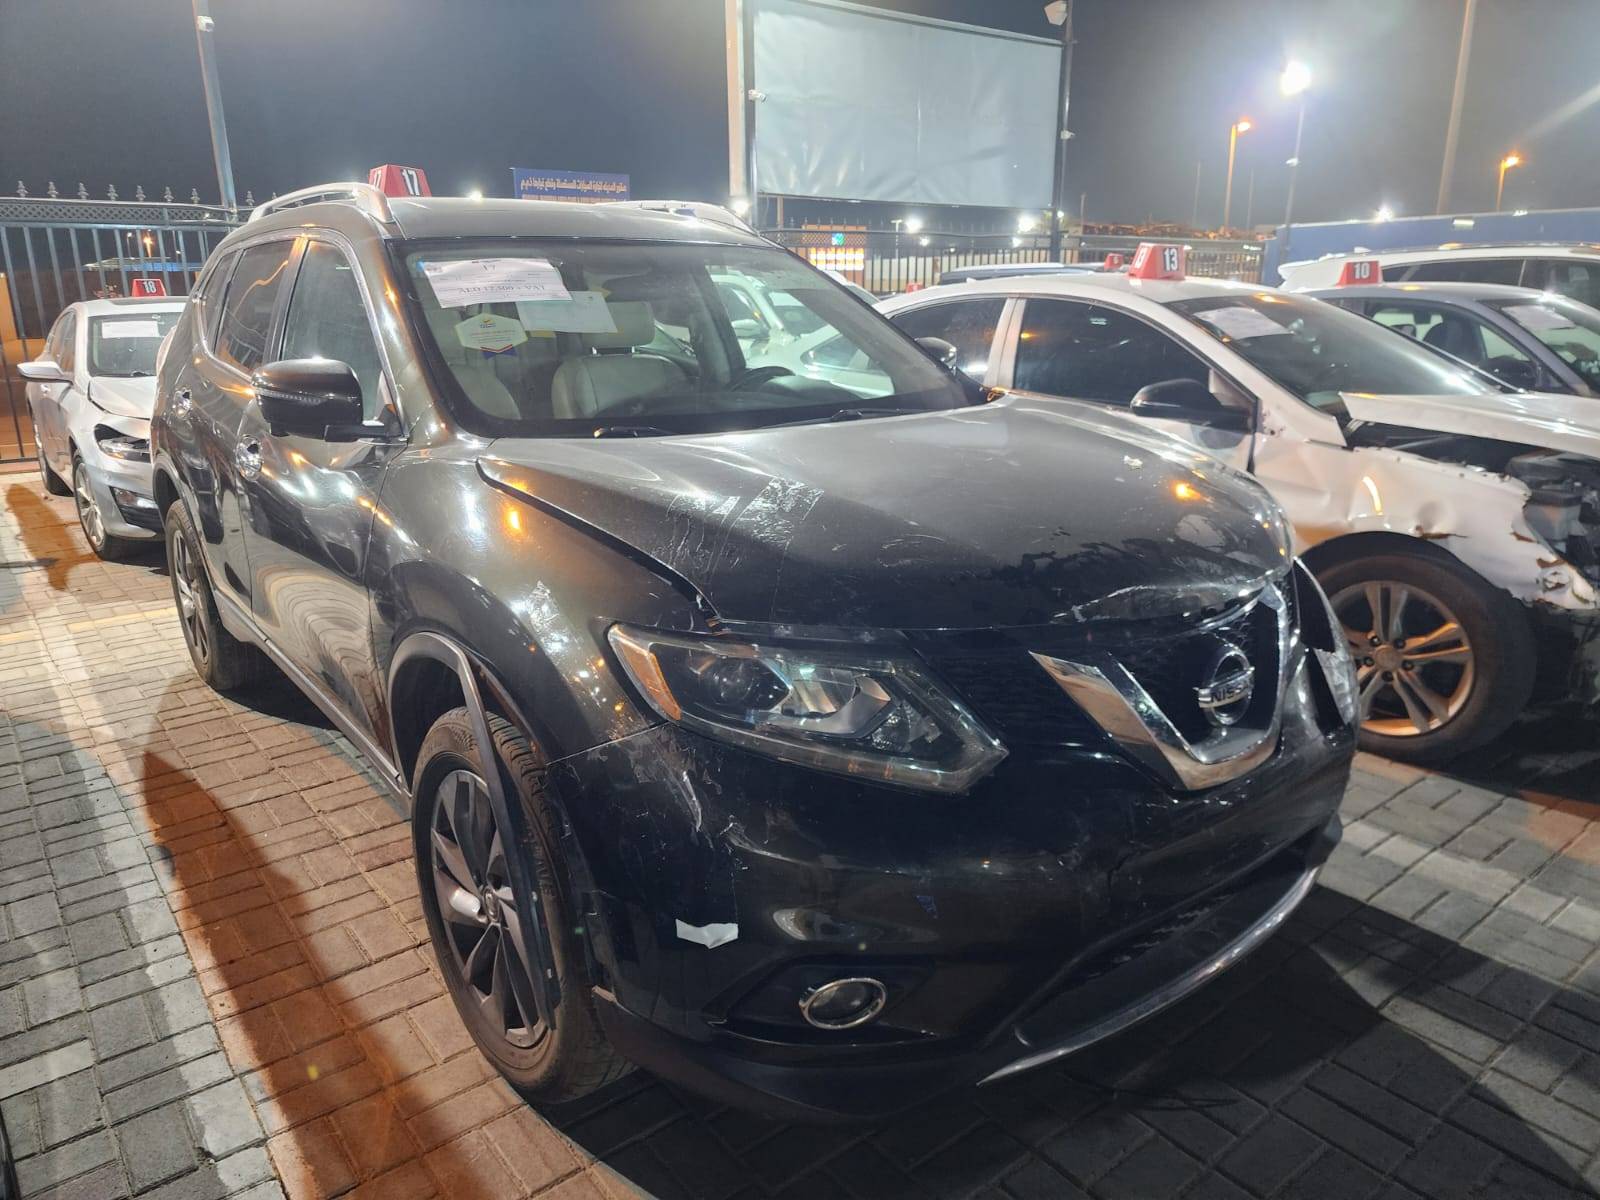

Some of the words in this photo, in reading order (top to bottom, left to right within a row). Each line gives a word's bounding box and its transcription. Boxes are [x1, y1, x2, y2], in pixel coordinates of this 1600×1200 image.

[401, 169, 421, 196] 17
[1163, 247, 1179, 272] 13
[1354, 262, 1370, 279] 10
[143, 280, 157, 294] 18
